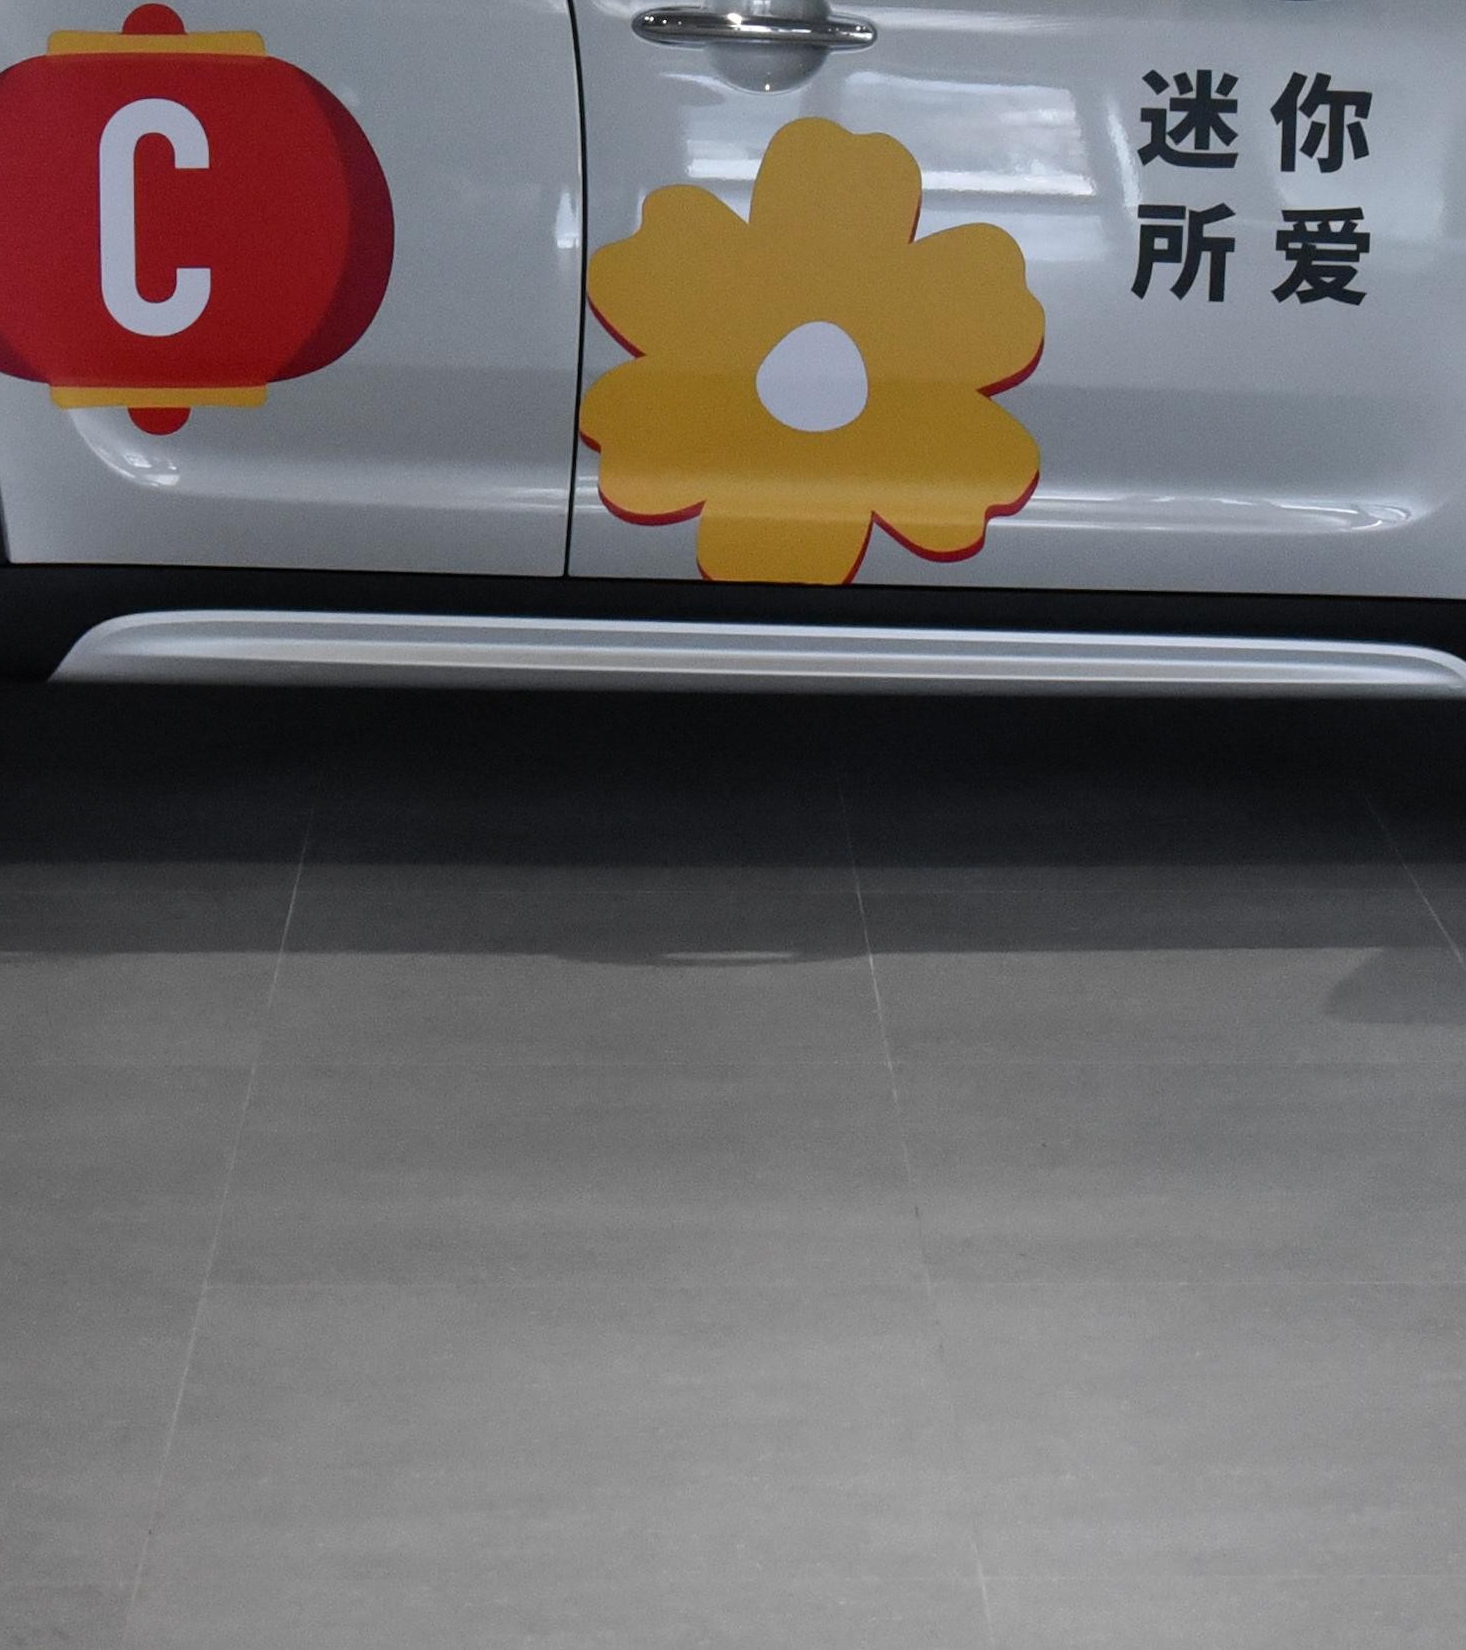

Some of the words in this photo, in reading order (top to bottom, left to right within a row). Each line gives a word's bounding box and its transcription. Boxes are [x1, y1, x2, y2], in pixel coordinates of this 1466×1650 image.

[1137, 69, 1373, 174] 迷你
[99, 98, 211, 337] C
[1131, 203, 1371, 306] 所爱
